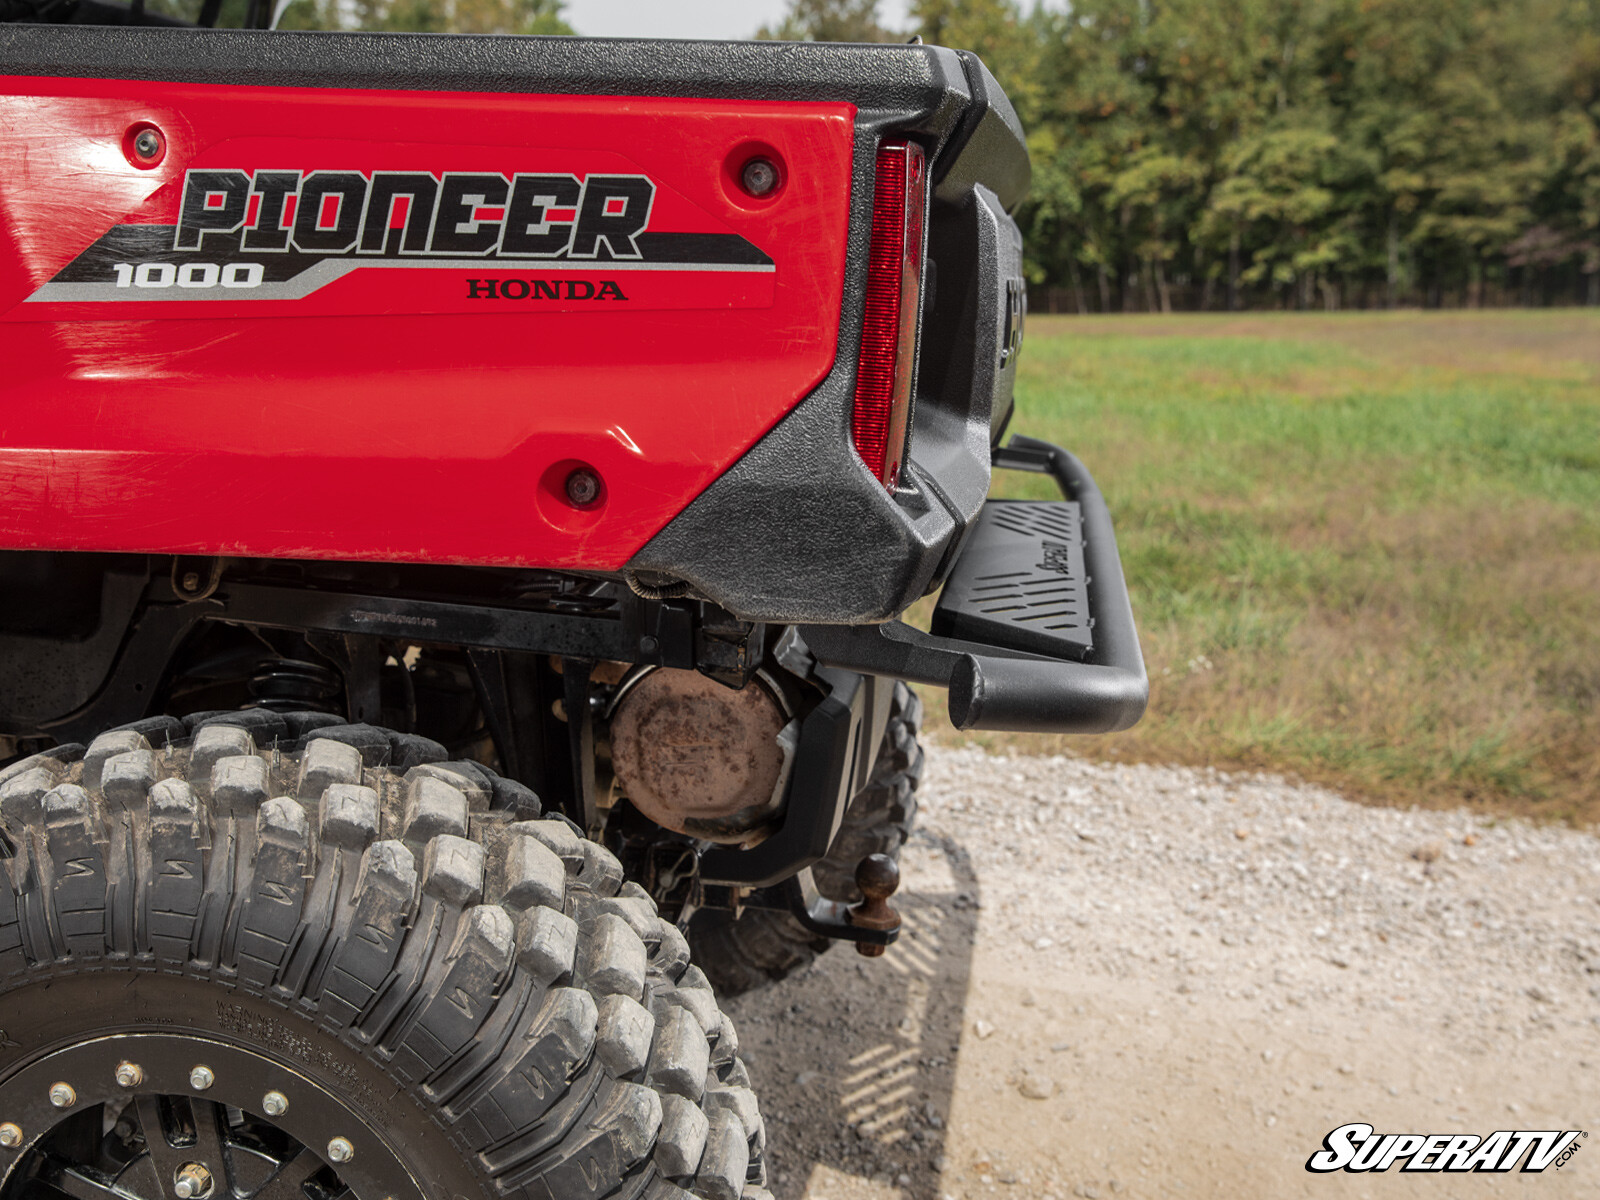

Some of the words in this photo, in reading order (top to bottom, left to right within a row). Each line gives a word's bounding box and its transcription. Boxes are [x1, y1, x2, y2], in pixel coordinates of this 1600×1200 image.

[172, 169, 656, 259] PIONEER
[113, 262, 265, 288] 1000
[466, 279, 629, 301] HONDA
